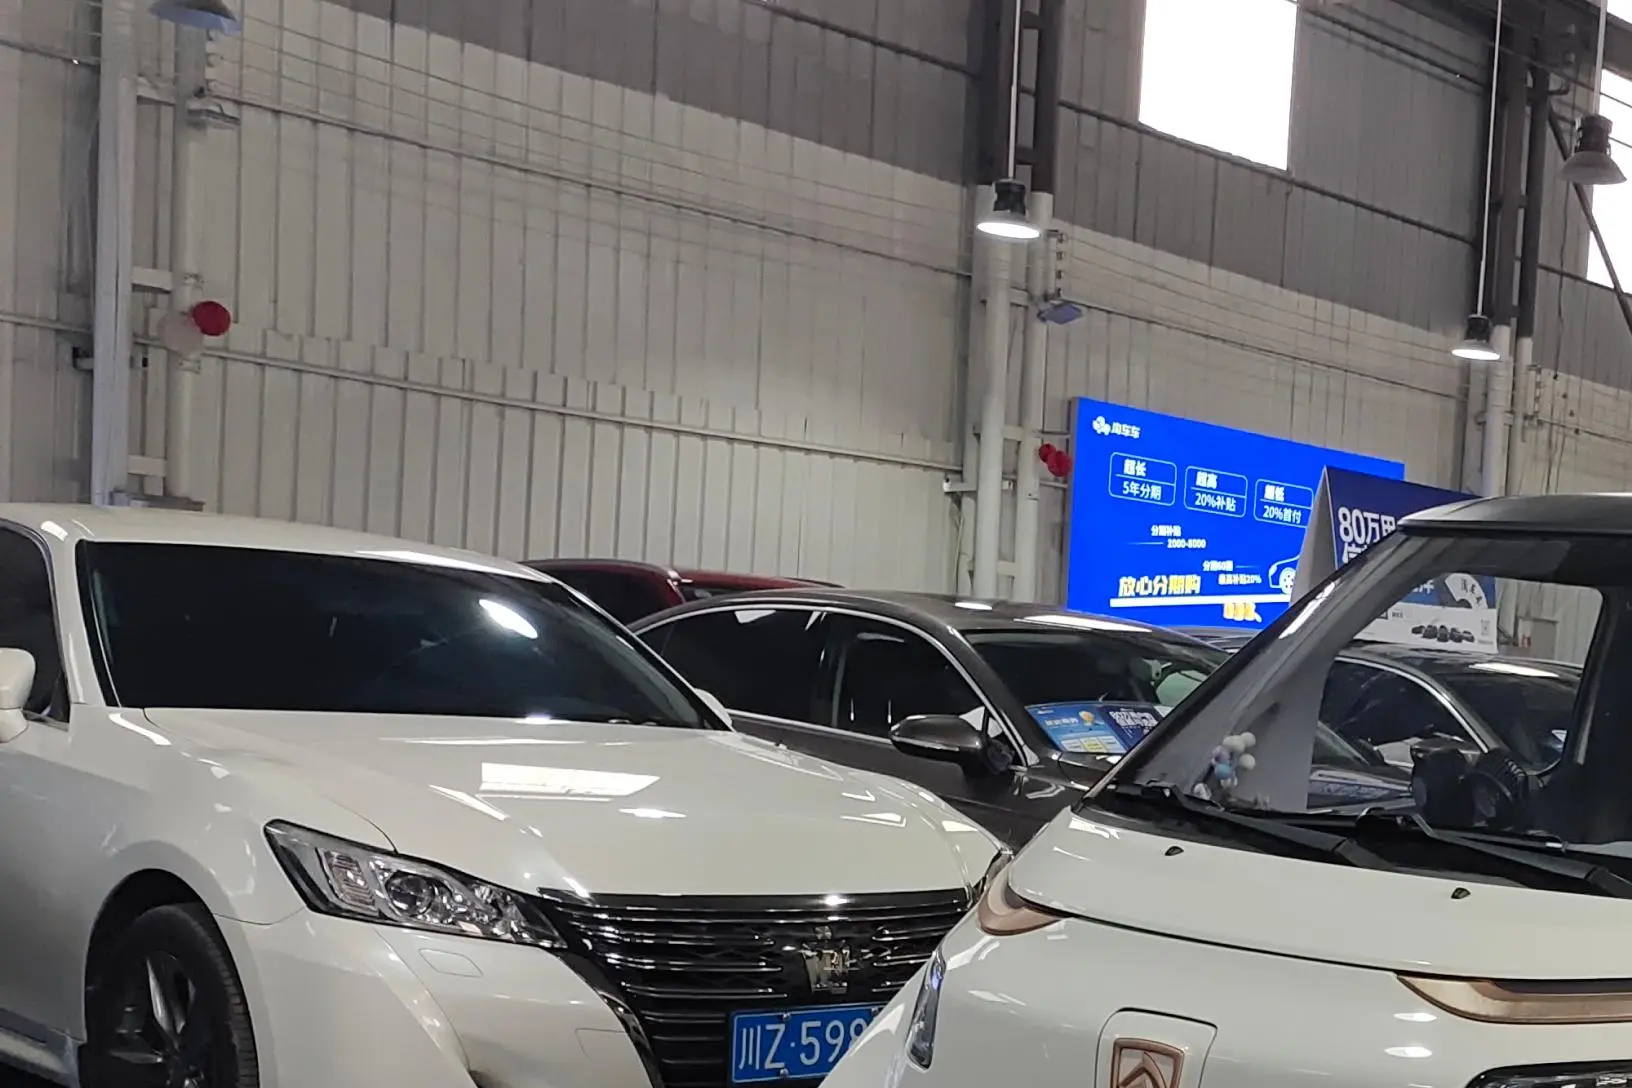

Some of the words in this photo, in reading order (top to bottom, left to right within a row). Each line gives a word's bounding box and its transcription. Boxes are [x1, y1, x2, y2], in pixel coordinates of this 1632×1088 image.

[1123, 458, 1147, 477] 超长
[1122, 481, 1162, 501] 5年分期
[1195, 493, 1237, 512] 20%补贴
[1262, 505, 1301, 524] 20%首付
[1118, 574, 1201, 597] 放心分期购
